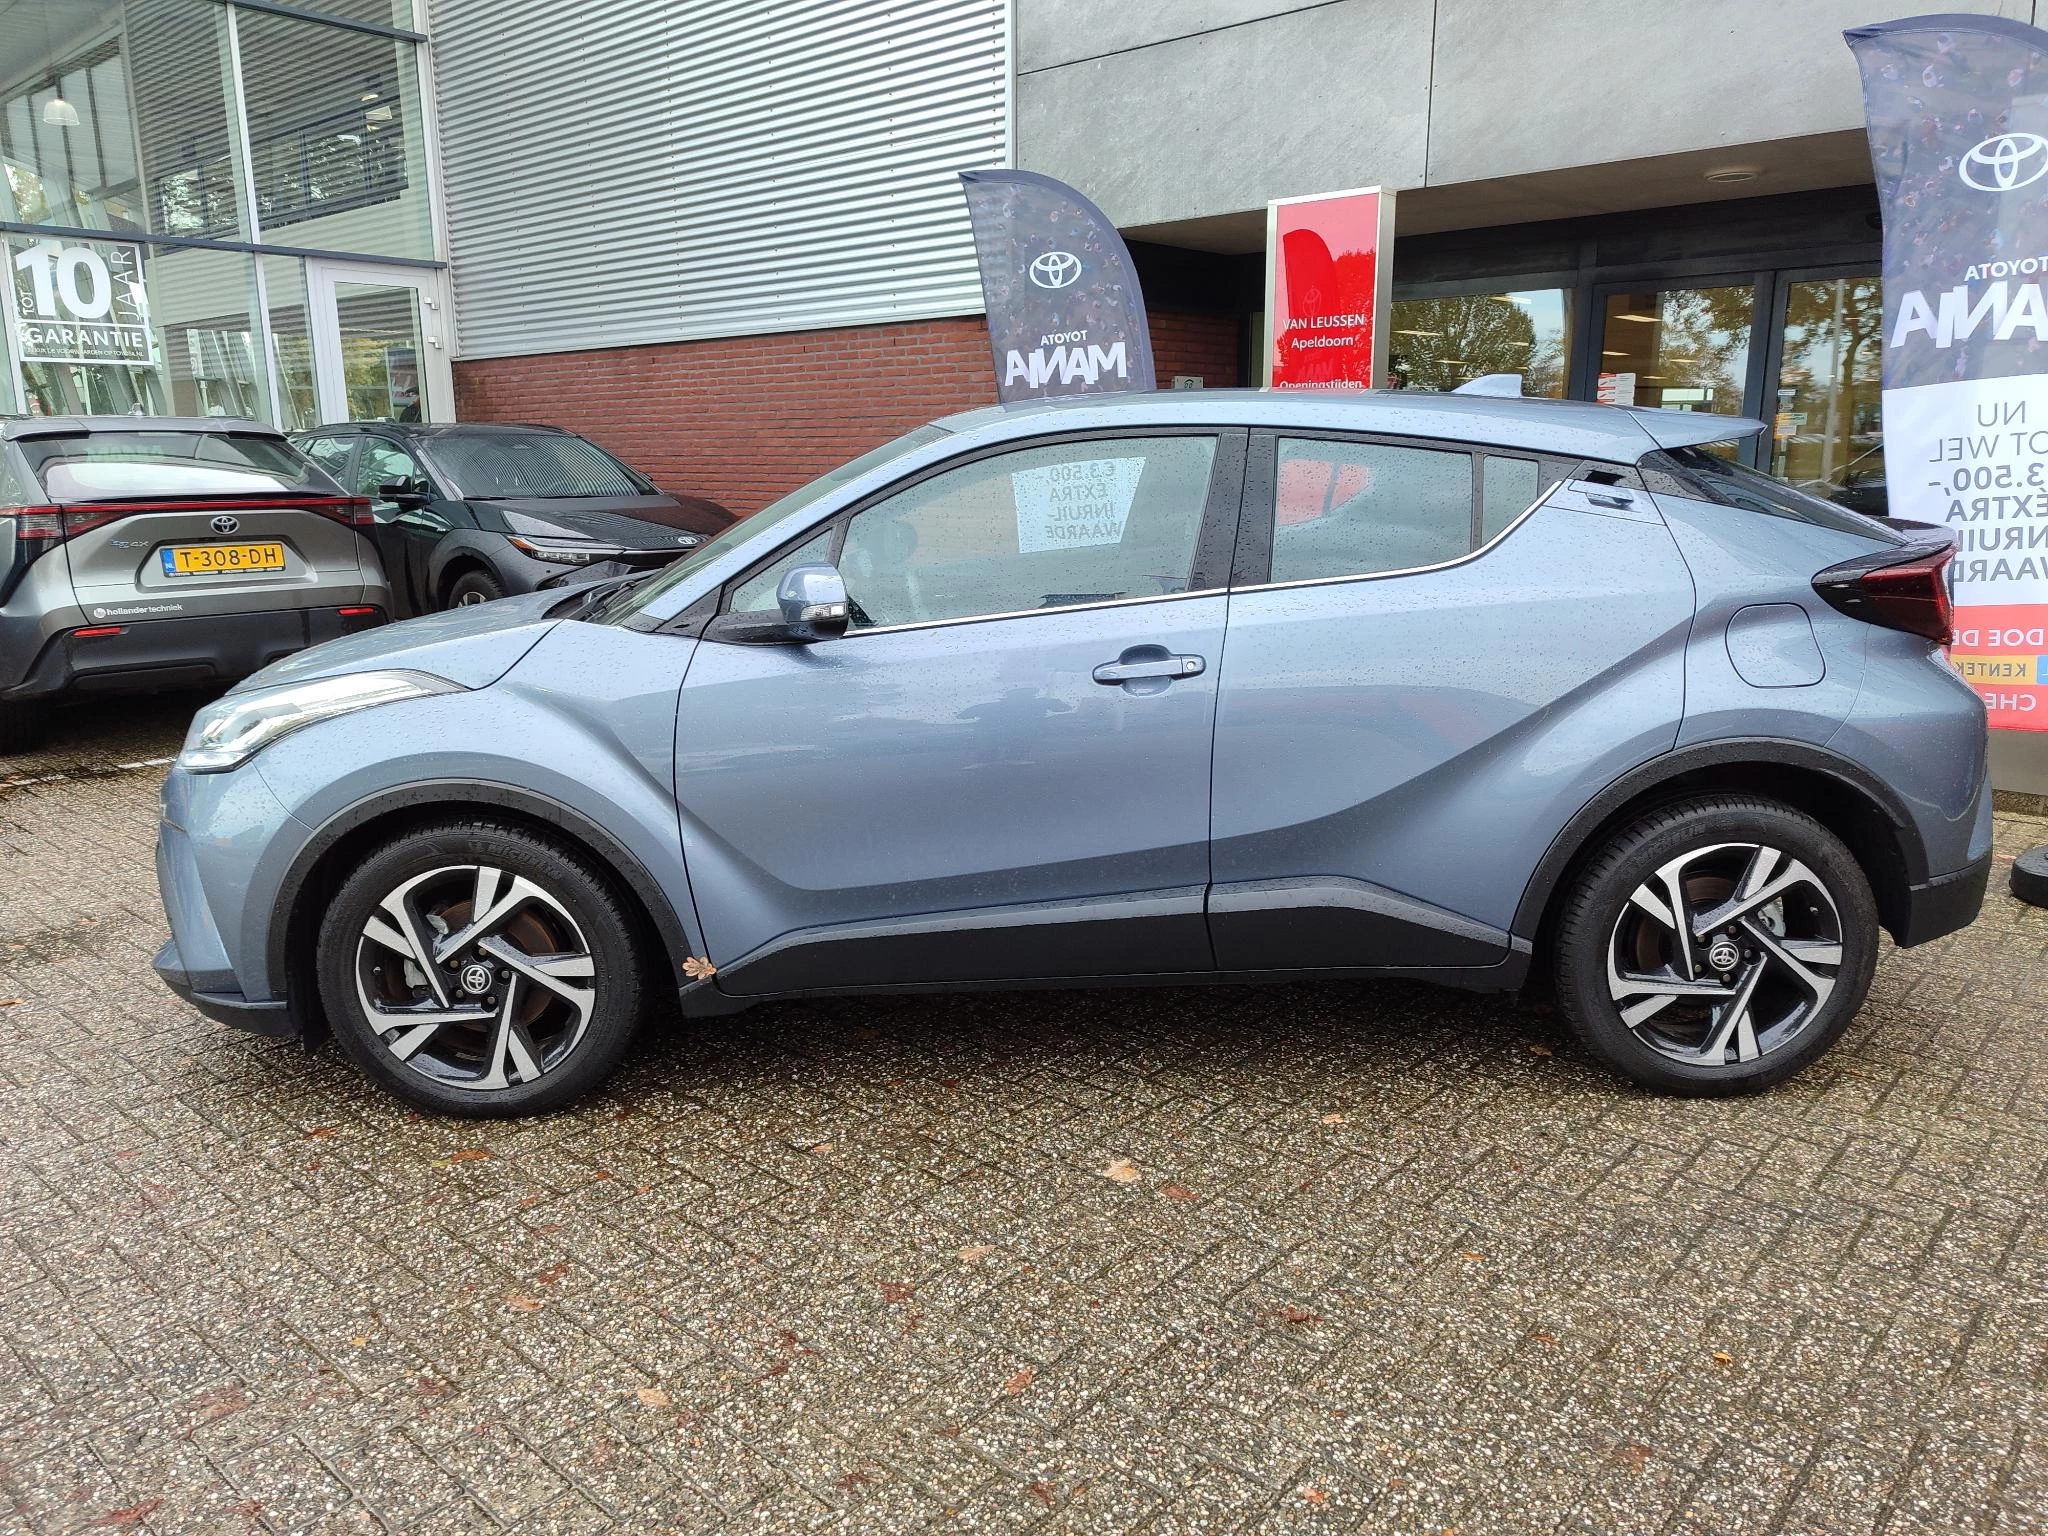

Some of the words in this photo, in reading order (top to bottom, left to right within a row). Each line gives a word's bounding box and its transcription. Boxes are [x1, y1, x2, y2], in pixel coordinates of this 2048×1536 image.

[16, 241, 112, 318] 10
[111, 250, 141, 320] JAAR
[21, 291, 35, 315] TOT
[1283, 317, 1307, 330] VAN
[1310, 313, 1364, 329] LEUSSEN
[29, 327, 143, 348] GARANTIE
[1291, 334, 1354, 352] Apeldoorn
[180, 547, 277, 568] T-308-DH
